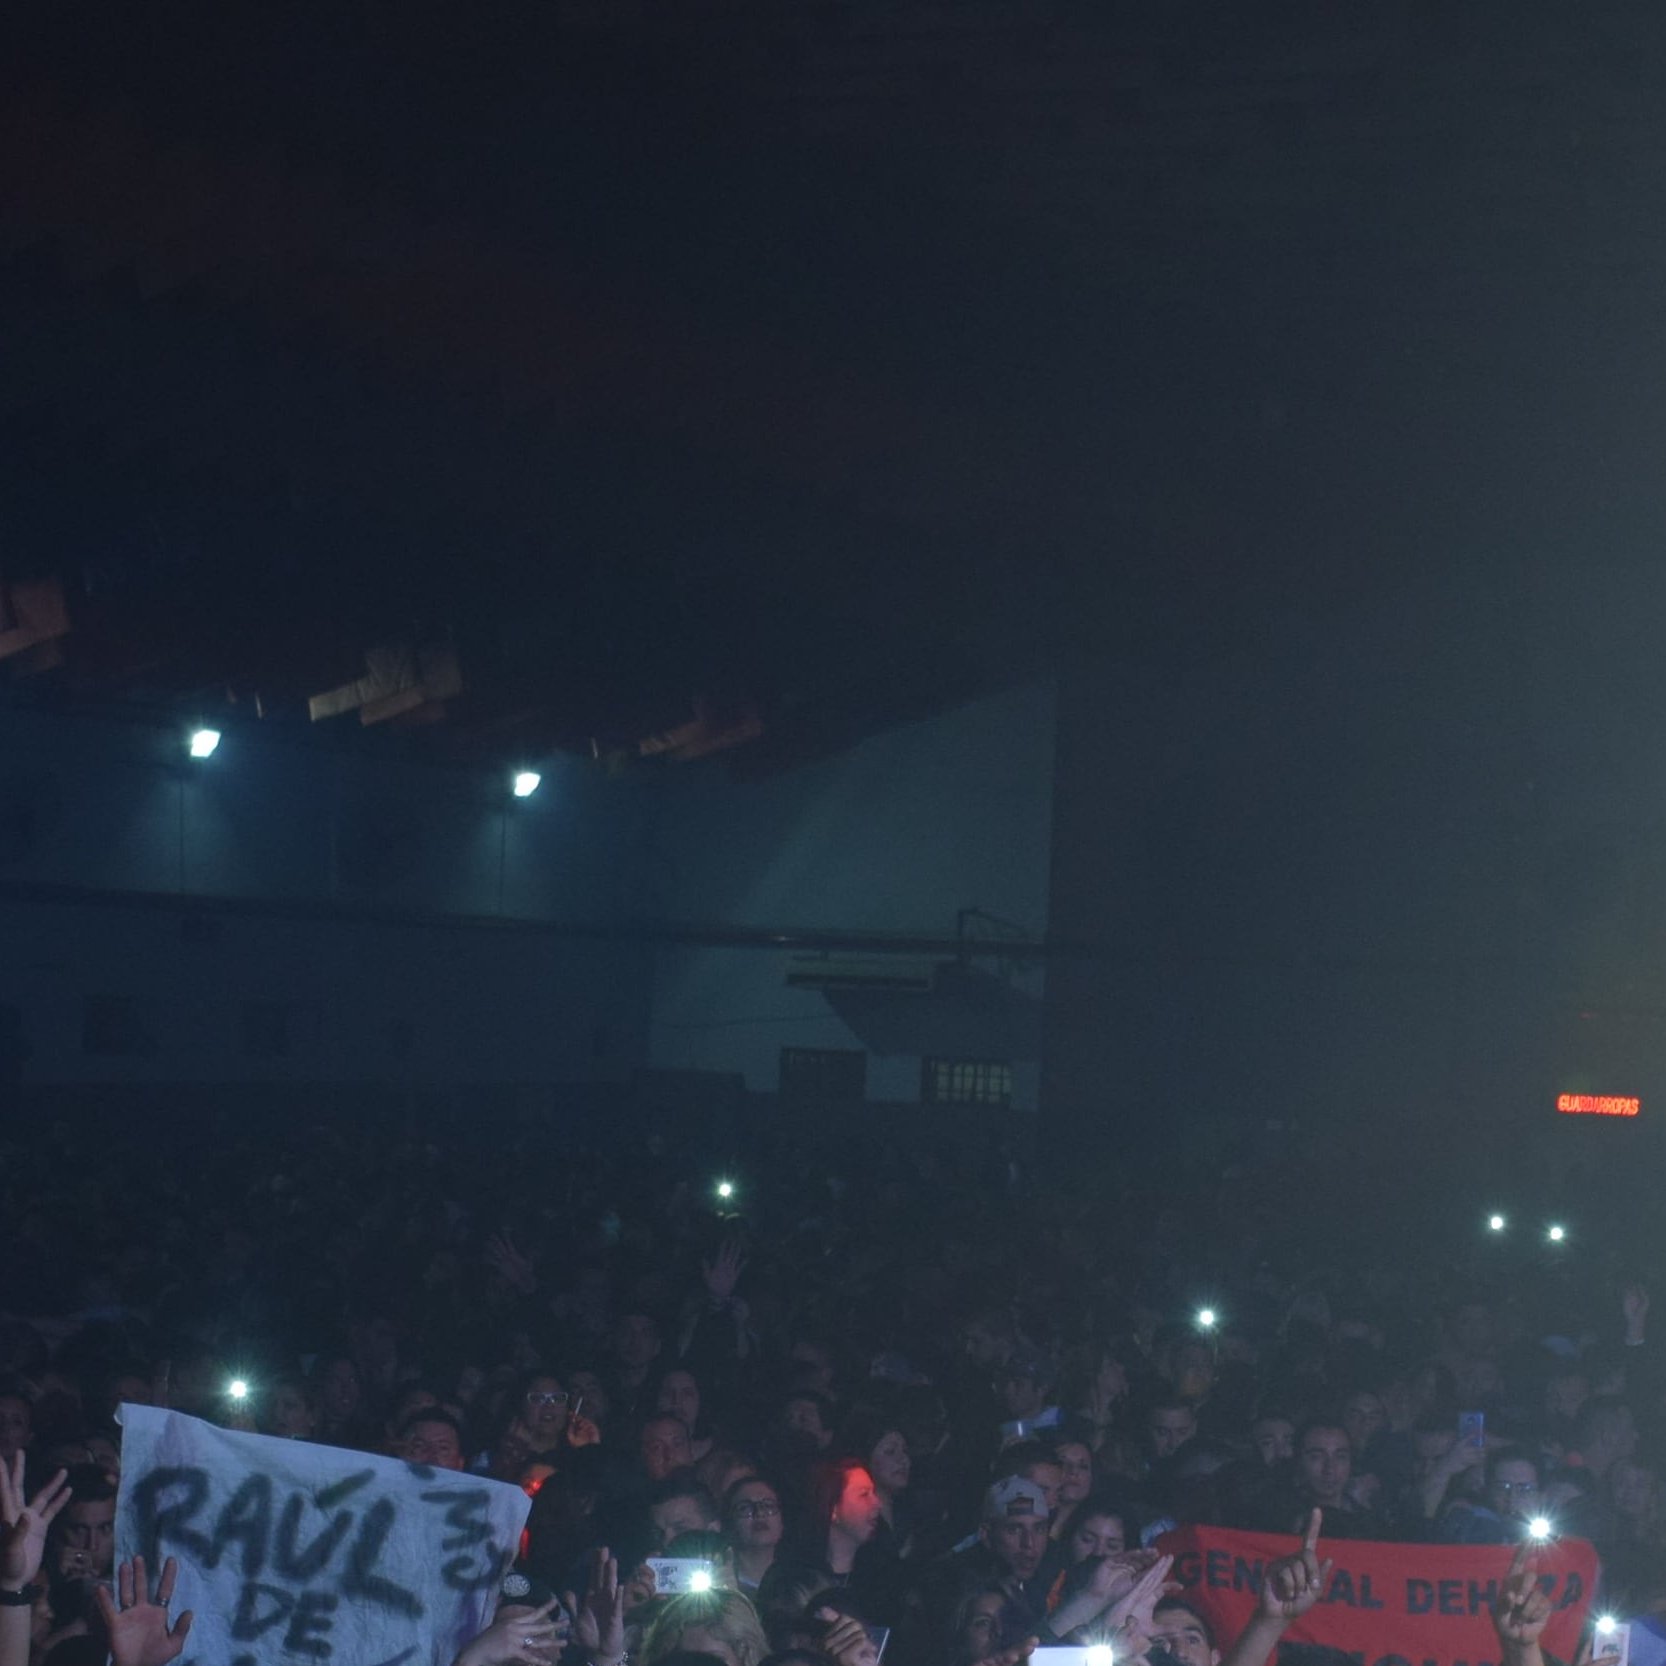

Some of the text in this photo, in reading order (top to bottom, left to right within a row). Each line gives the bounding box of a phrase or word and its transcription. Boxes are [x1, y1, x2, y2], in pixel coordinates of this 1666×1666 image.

[1557, 1094, 1640, 1116] GUARDARROPAS
[133, 1464, 424, 1620] RAÚL
[1174, 1551, 1584, 1616] GENAL DEHZA
[231, 1582, 339, 1658] DE
